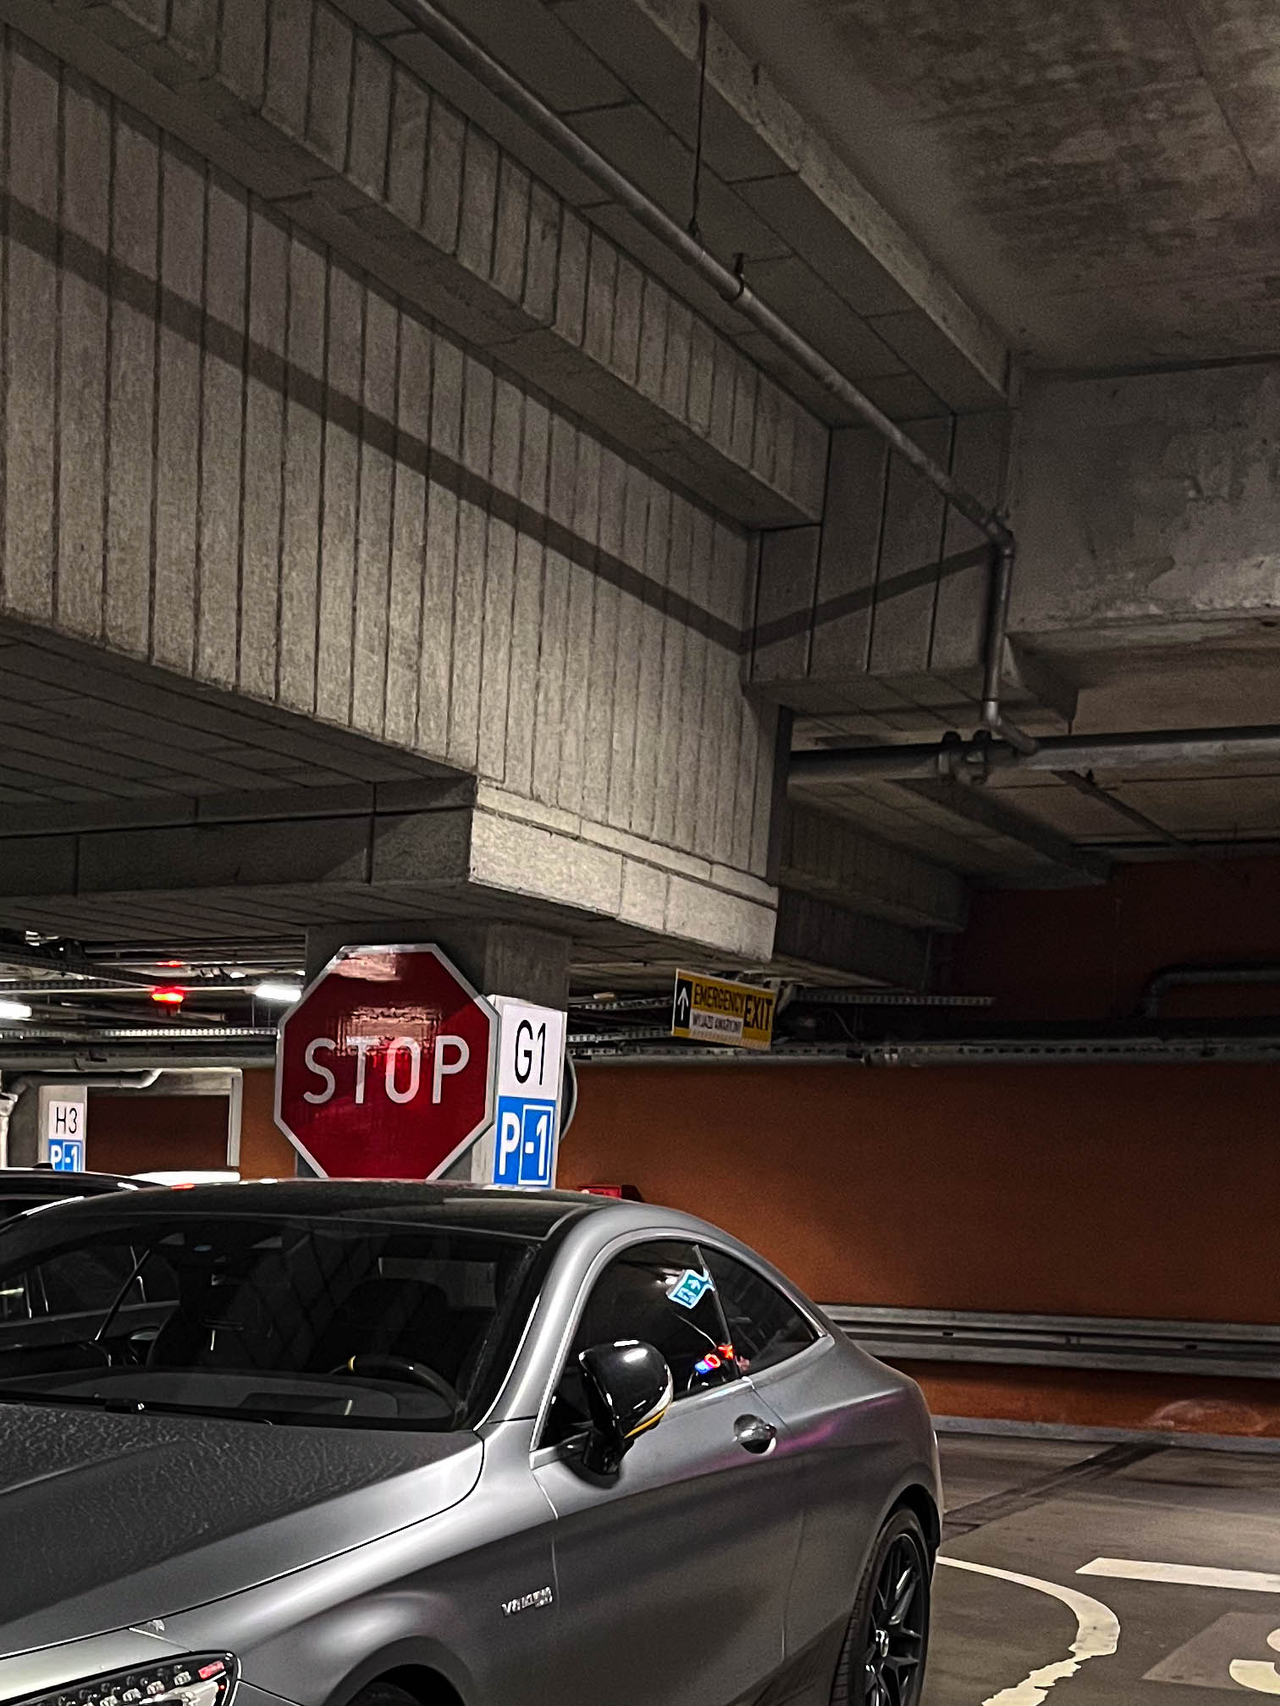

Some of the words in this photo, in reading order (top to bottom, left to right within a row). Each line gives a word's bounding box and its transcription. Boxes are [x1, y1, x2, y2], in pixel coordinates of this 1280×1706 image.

[693, 982, 743, 1014] EMERGENCY
[744, 995, 773, 1031] EXIT
[303, 1035, 470, 1104] STOP
[514, 1019, 547, 1086] G1
[55, 1106, 78, 1134] H3
